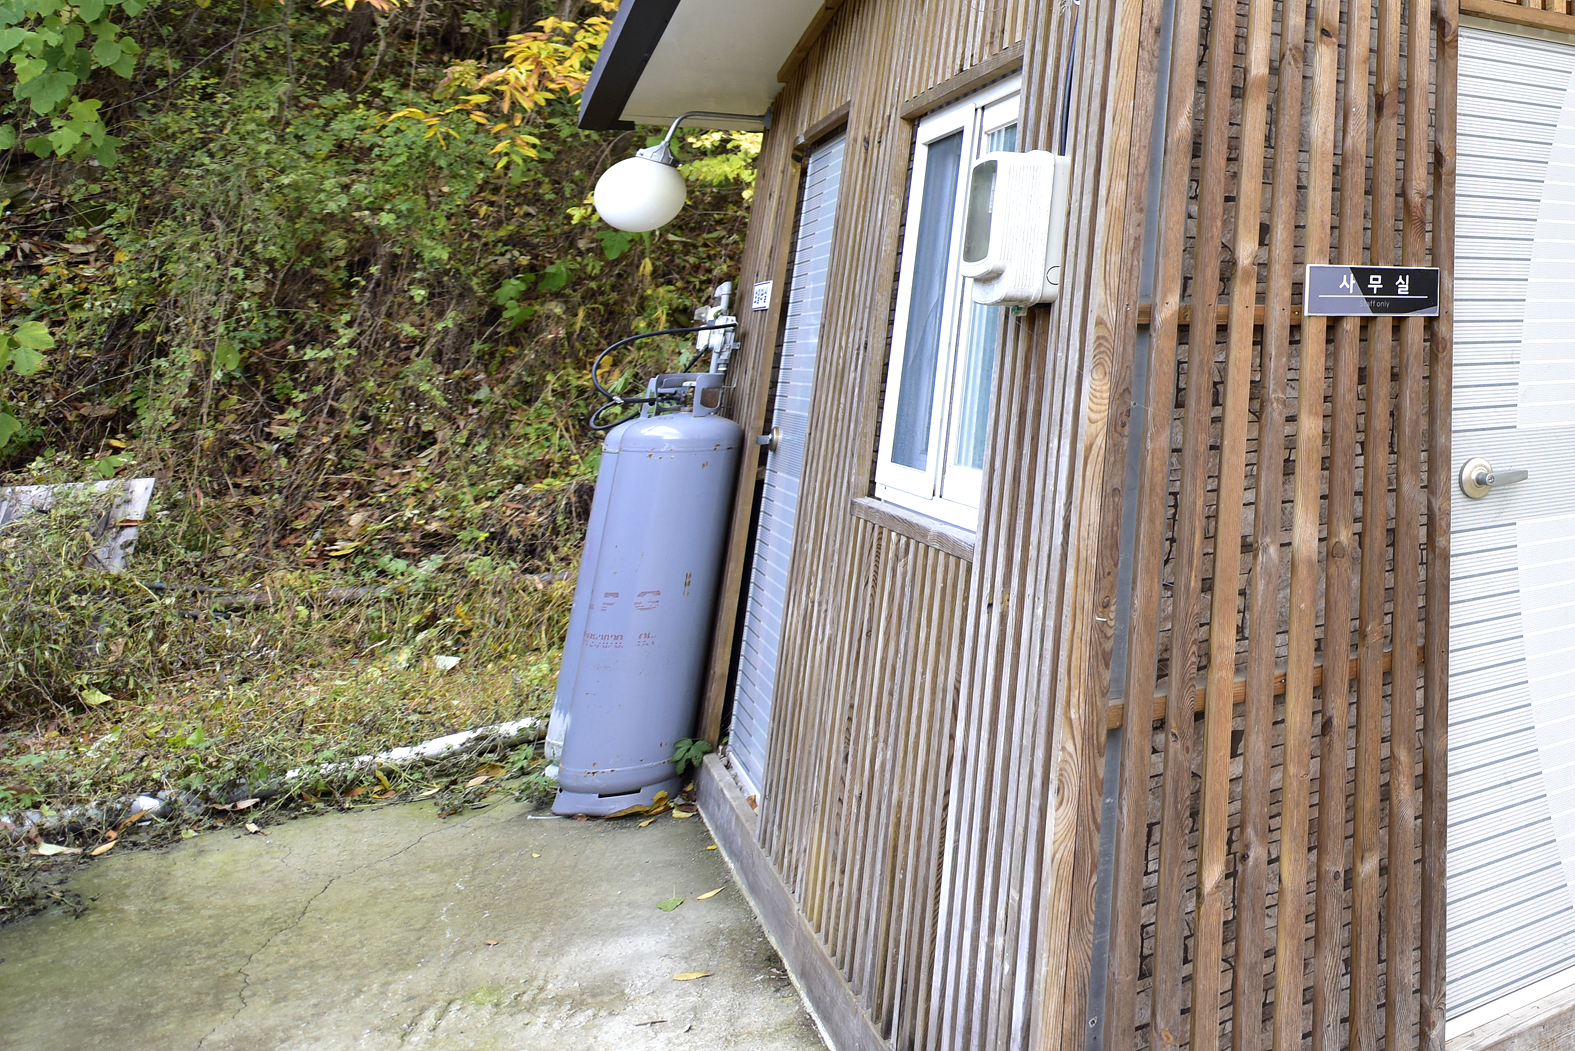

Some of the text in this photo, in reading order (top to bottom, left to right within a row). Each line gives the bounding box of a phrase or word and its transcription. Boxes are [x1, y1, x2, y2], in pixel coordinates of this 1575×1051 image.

[1338, 273, 1410, 295] 사무실
[1359, 299, 1391, 309] Staff only
